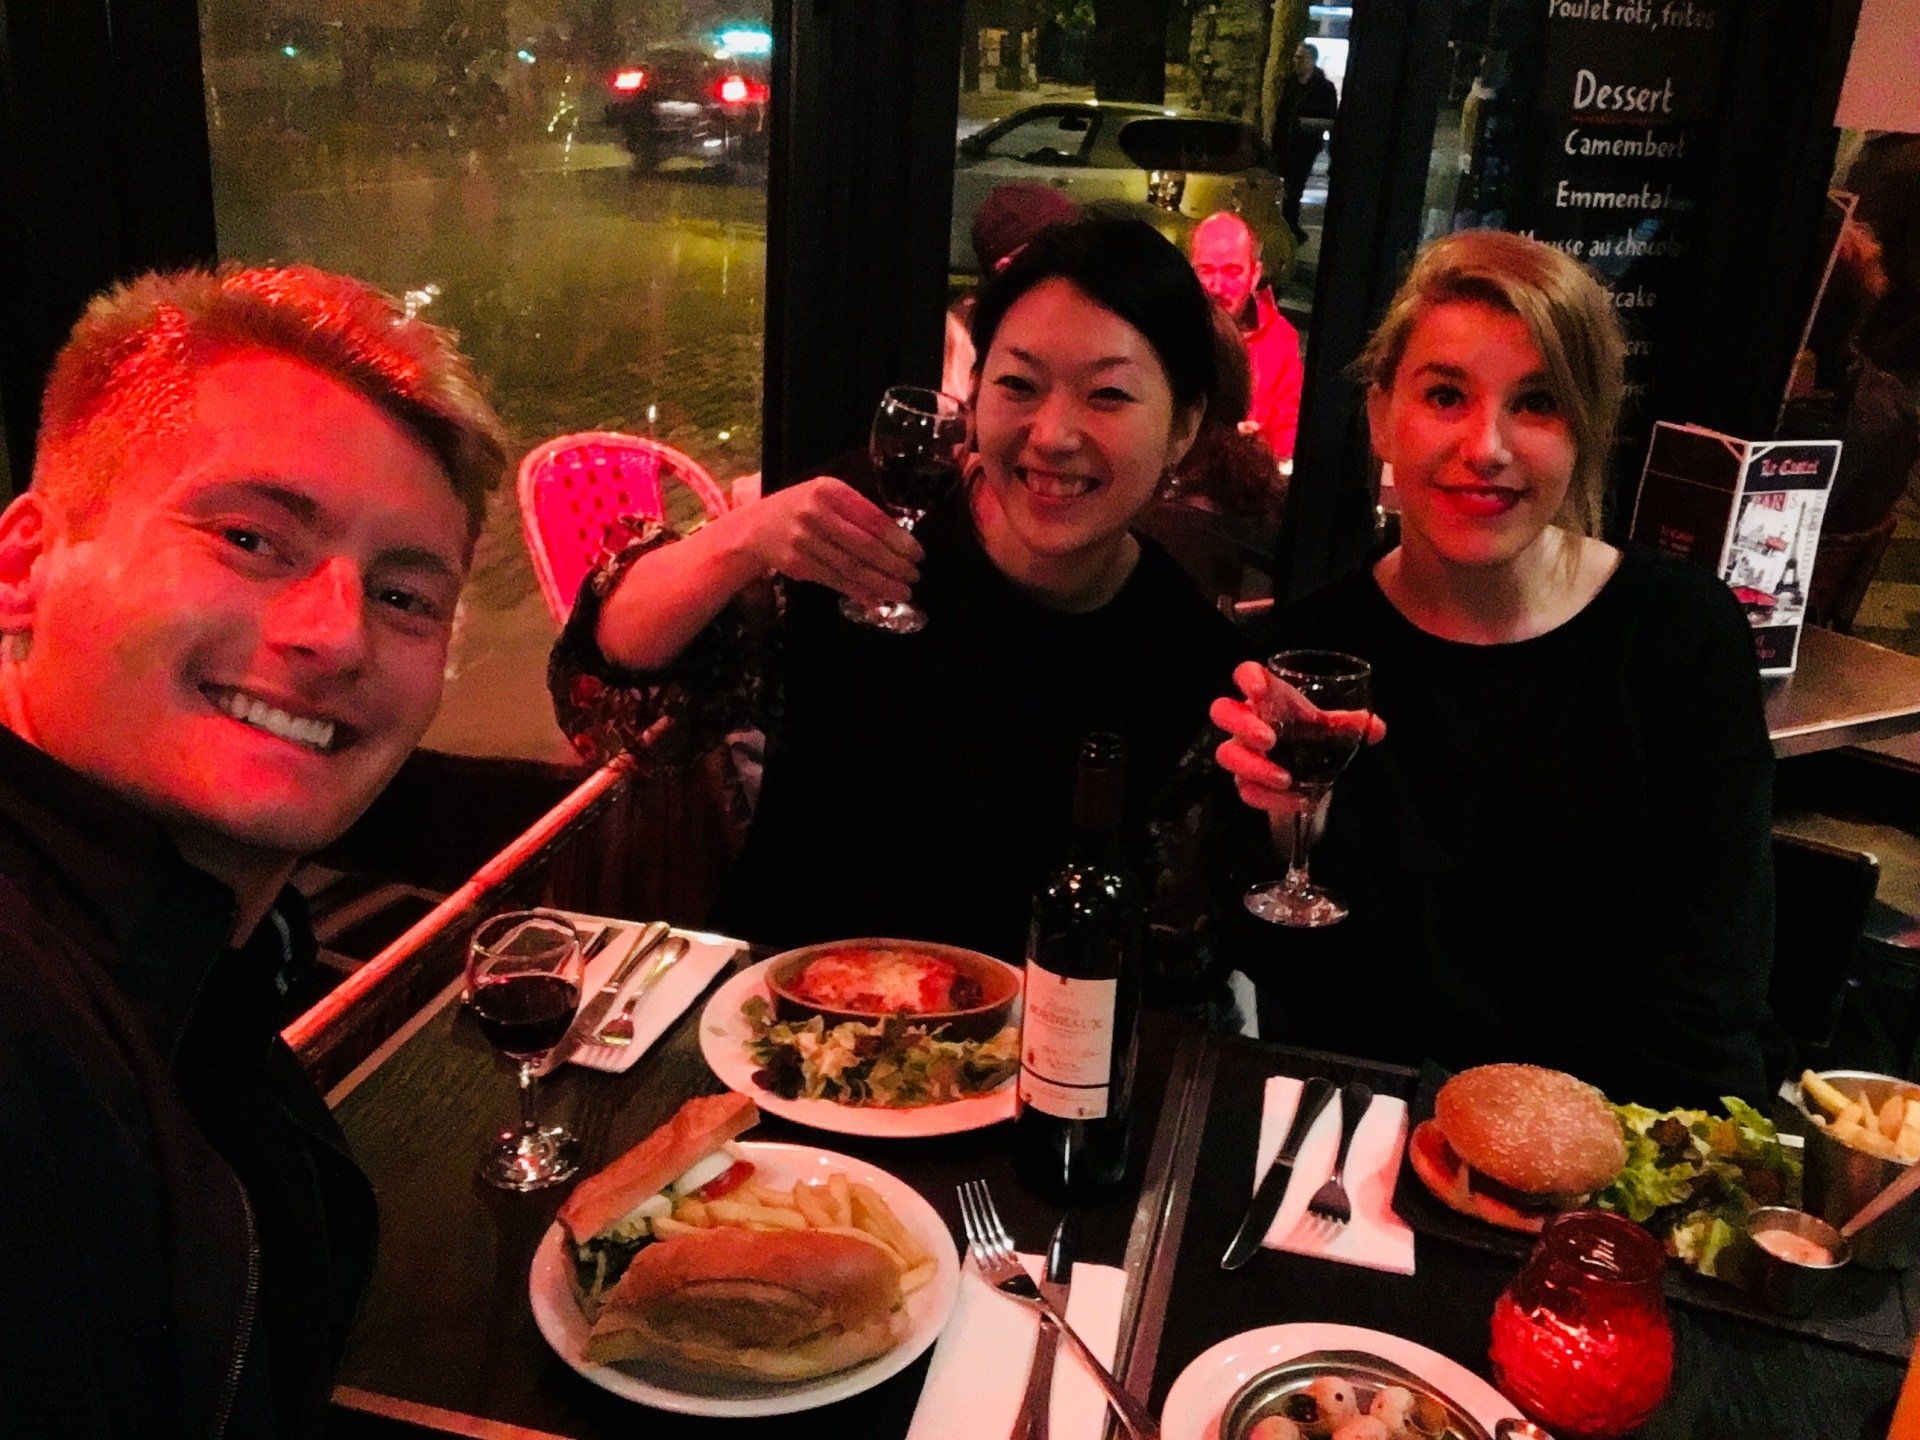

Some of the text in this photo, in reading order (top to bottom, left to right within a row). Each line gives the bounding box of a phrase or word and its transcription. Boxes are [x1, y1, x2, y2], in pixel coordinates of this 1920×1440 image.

[1548, 0, 1610, 21] Poulet
[1572, 69, 1674, 114] Dessert
[1564, 128, 1686, 158] Camembert
[1588, 239, 1612, 258] au
